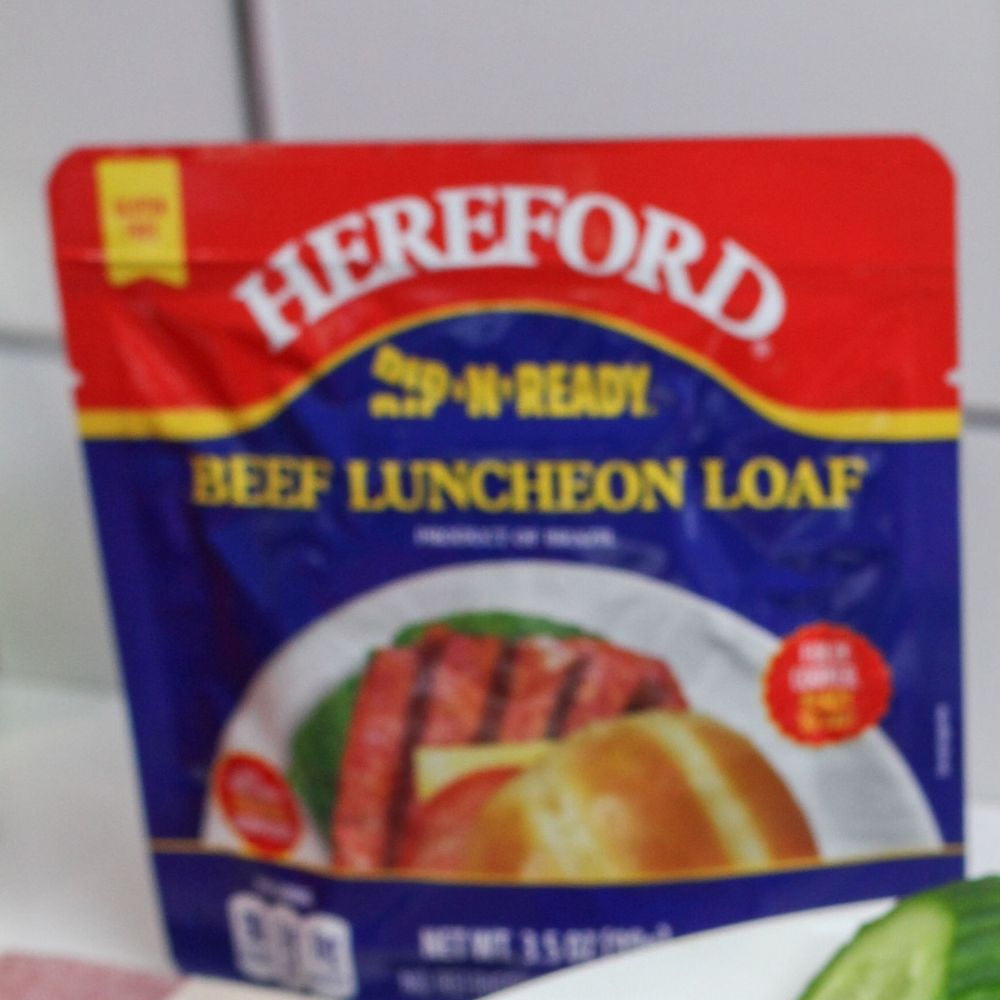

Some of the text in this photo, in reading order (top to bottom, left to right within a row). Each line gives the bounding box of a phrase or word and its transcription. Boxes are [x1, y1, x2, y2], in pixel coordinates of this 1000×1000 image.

[233, 184, 785, 354] HEREFORD
[191, 455, 868, 513] BEEF LUNCHEON LOAF
